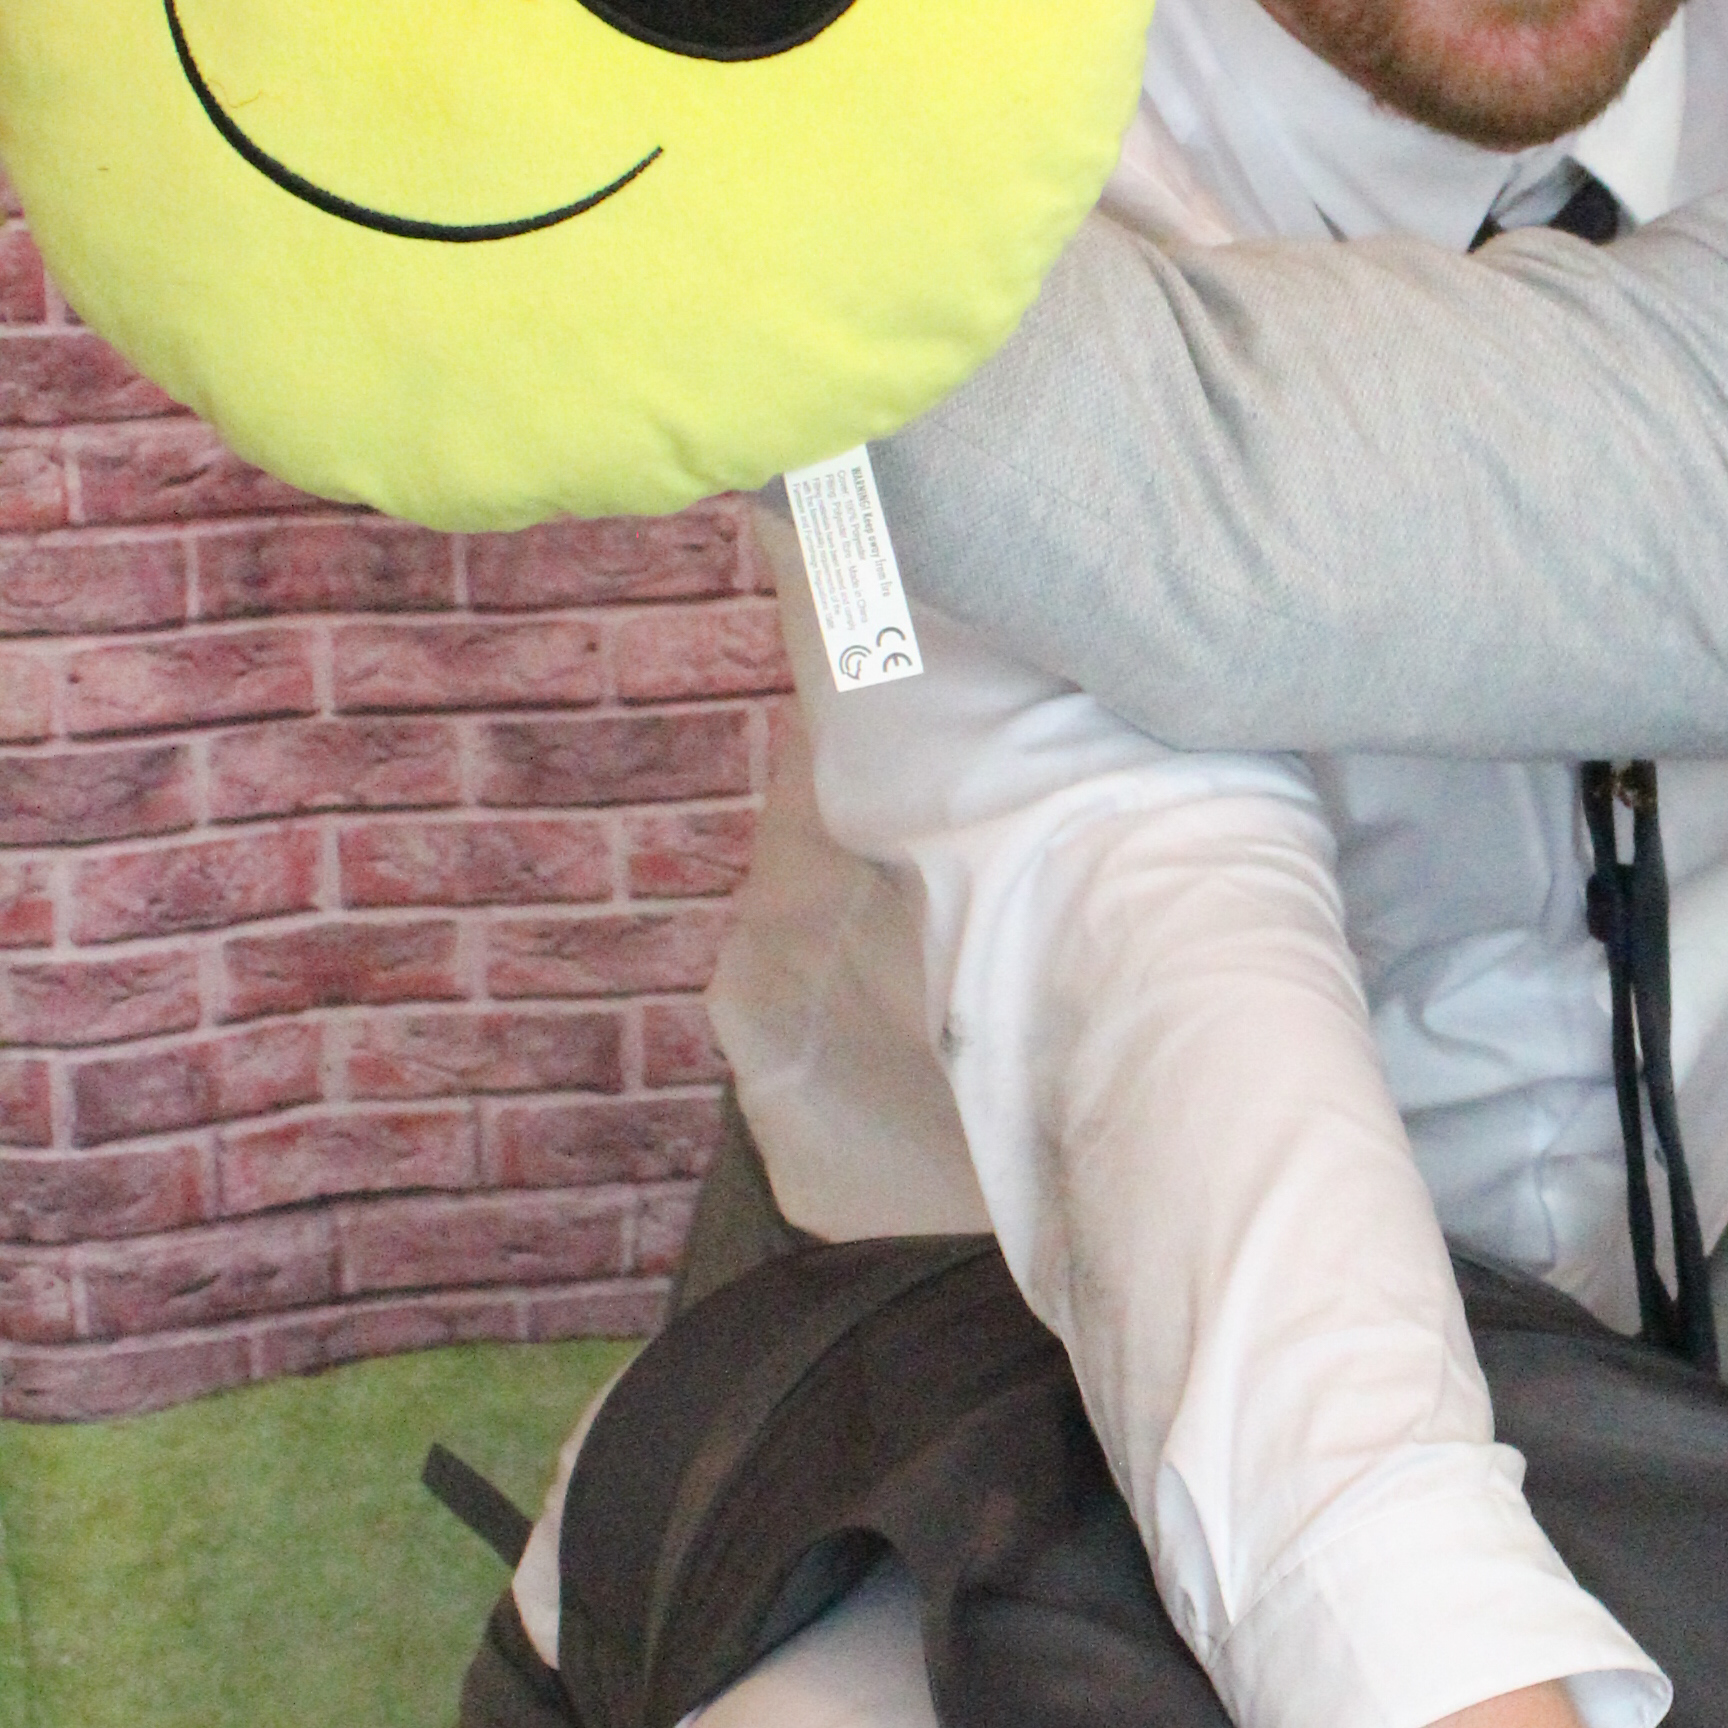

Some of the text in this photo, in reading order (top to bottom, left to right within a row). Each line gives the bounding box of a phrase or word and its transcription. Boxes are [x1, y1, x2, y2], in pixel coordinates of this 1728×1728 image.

[851, 465, 894, 597] WARNING! Keep away from fire
[876, 626, 912, 673] CE
